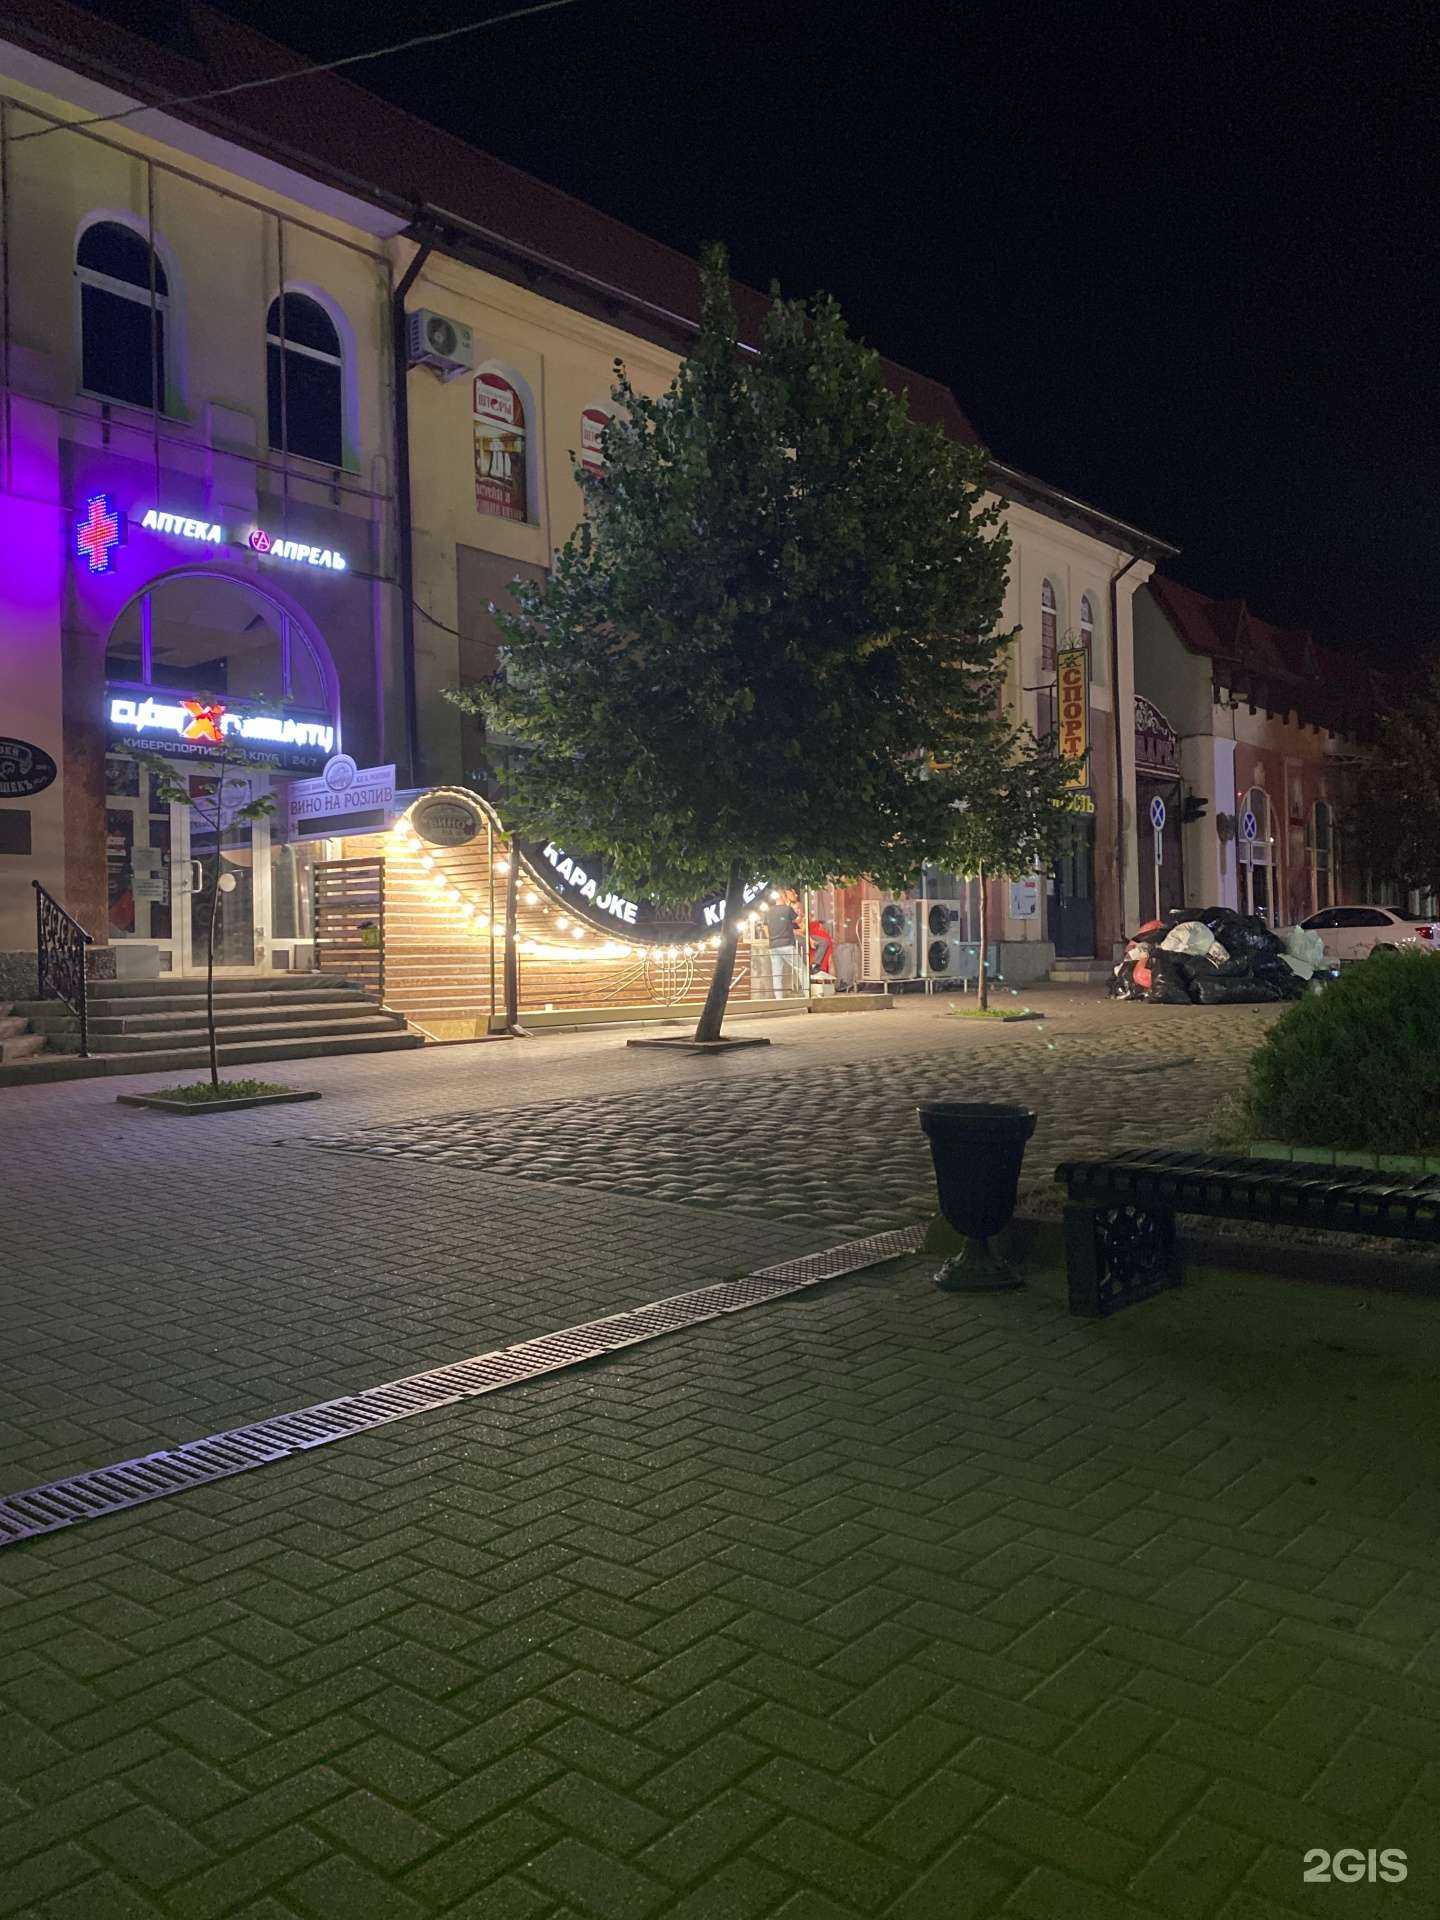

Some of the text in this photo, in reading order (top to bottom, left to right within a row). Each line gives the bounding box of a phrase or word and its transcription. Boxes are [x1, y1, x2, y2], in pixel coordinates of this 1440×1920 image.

[142, 510, 222, 544] АПТЕКА
[271, 539, 346, 570] АПРЕЛЬ
[1063, 669, 1083, 757] СПОРТ
[290, 798, 322, 816] ВИНО
[325, 794, 341, 811] НА
[344, 787, 393, 808] РОЗЛИВ
